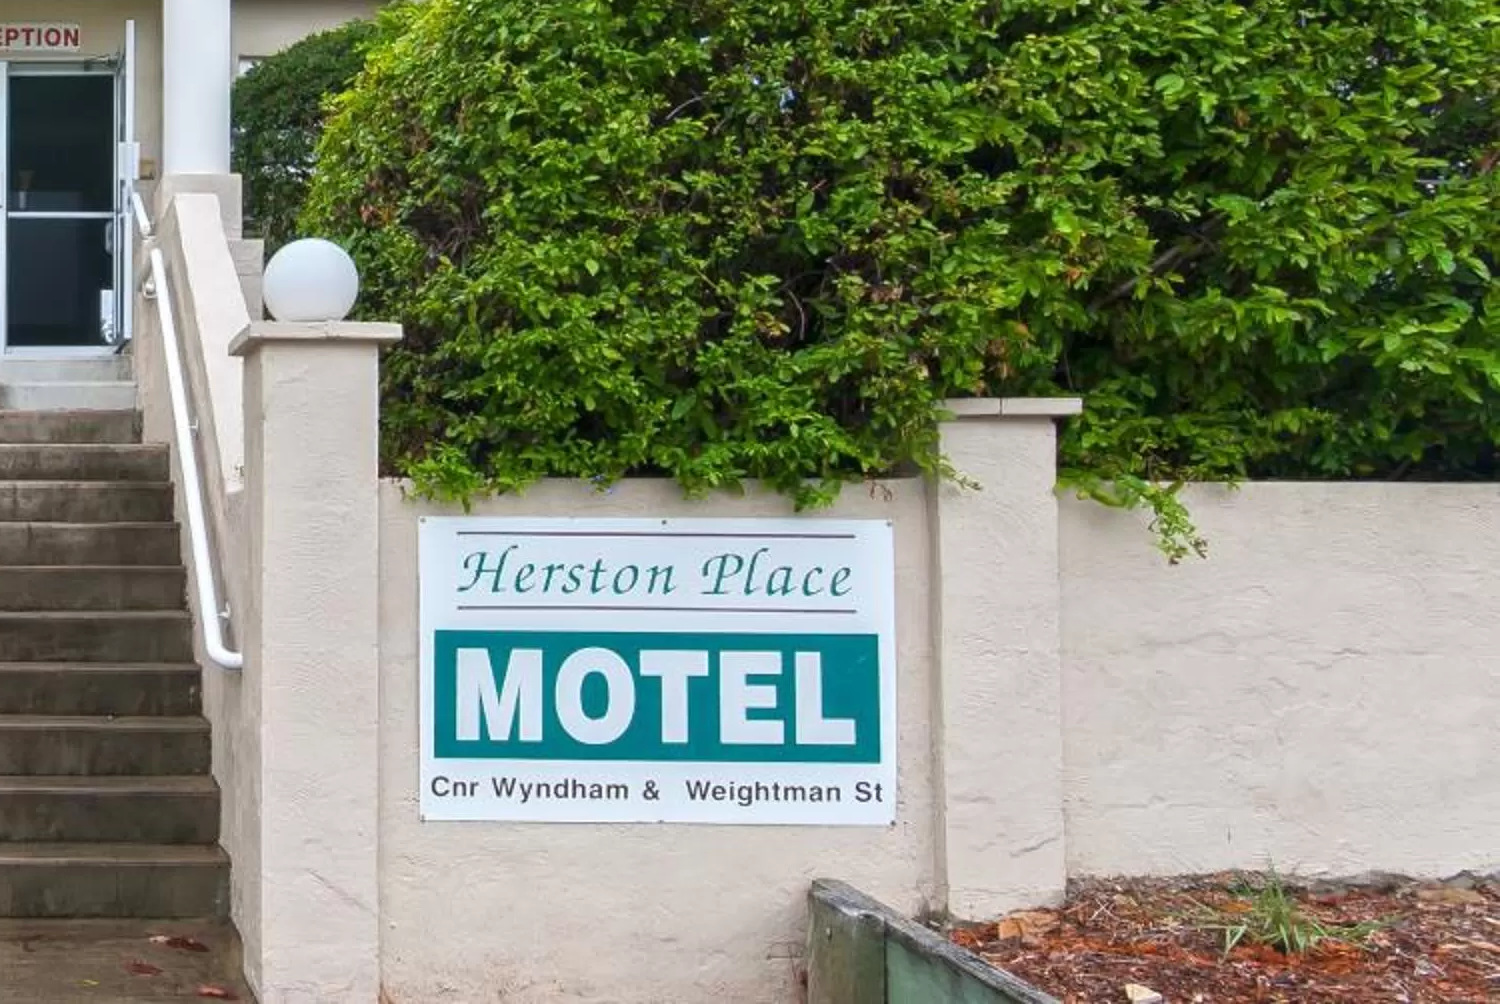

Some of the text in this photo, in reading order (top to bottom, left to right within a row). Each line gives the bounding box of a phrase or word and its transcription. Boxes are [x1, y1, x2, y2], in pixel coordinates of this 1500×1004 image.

[456, 545, 852, 597] Herston Place
[454, 646, 857, 745] MOTEL
[430, 776, 884, 807] Cnr Wyndham & Weightman St
